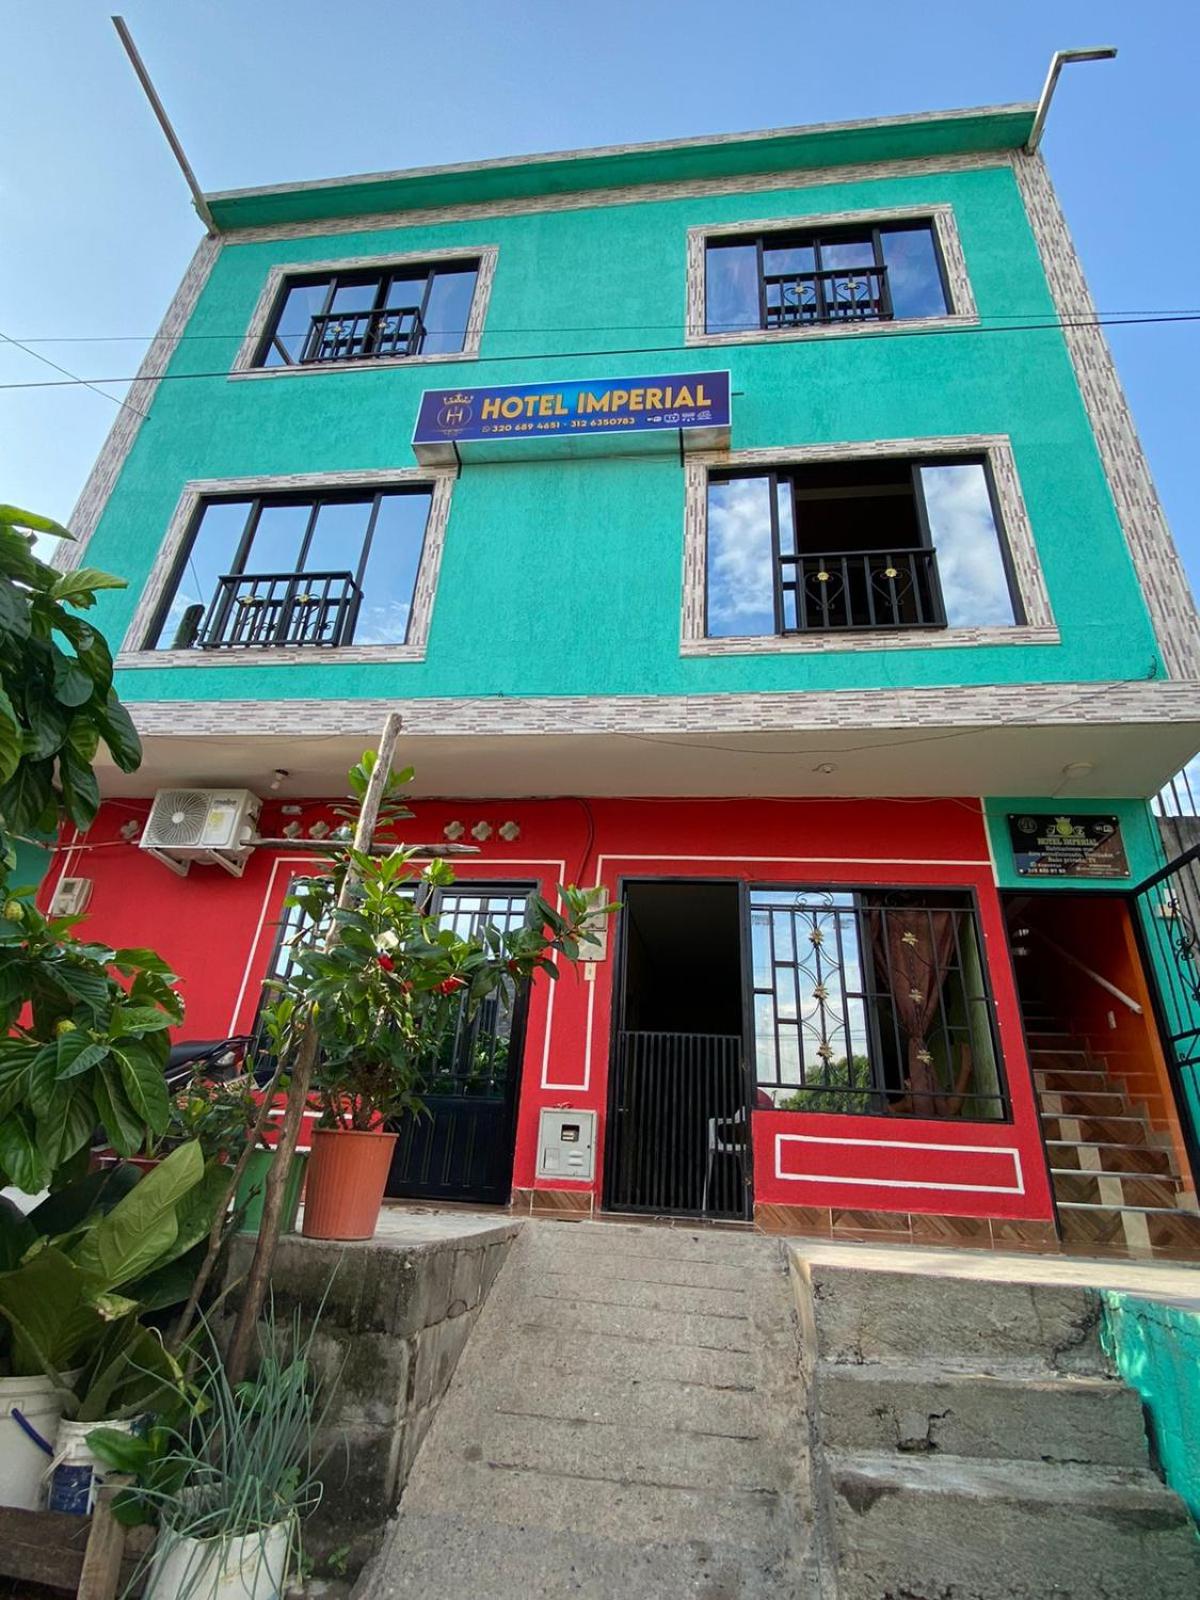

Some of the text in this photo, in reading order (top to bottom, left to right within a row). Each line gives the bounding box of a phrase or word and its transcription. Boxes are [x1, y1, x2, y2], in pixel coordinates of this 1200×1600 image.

[481, 385, 712, 420] HOTEL IMPERIAL
[491, 424, 512, 433] 320
[571, 420, 587, 428] 312
[1064, 838, 1099, 846] IMPERIAL
